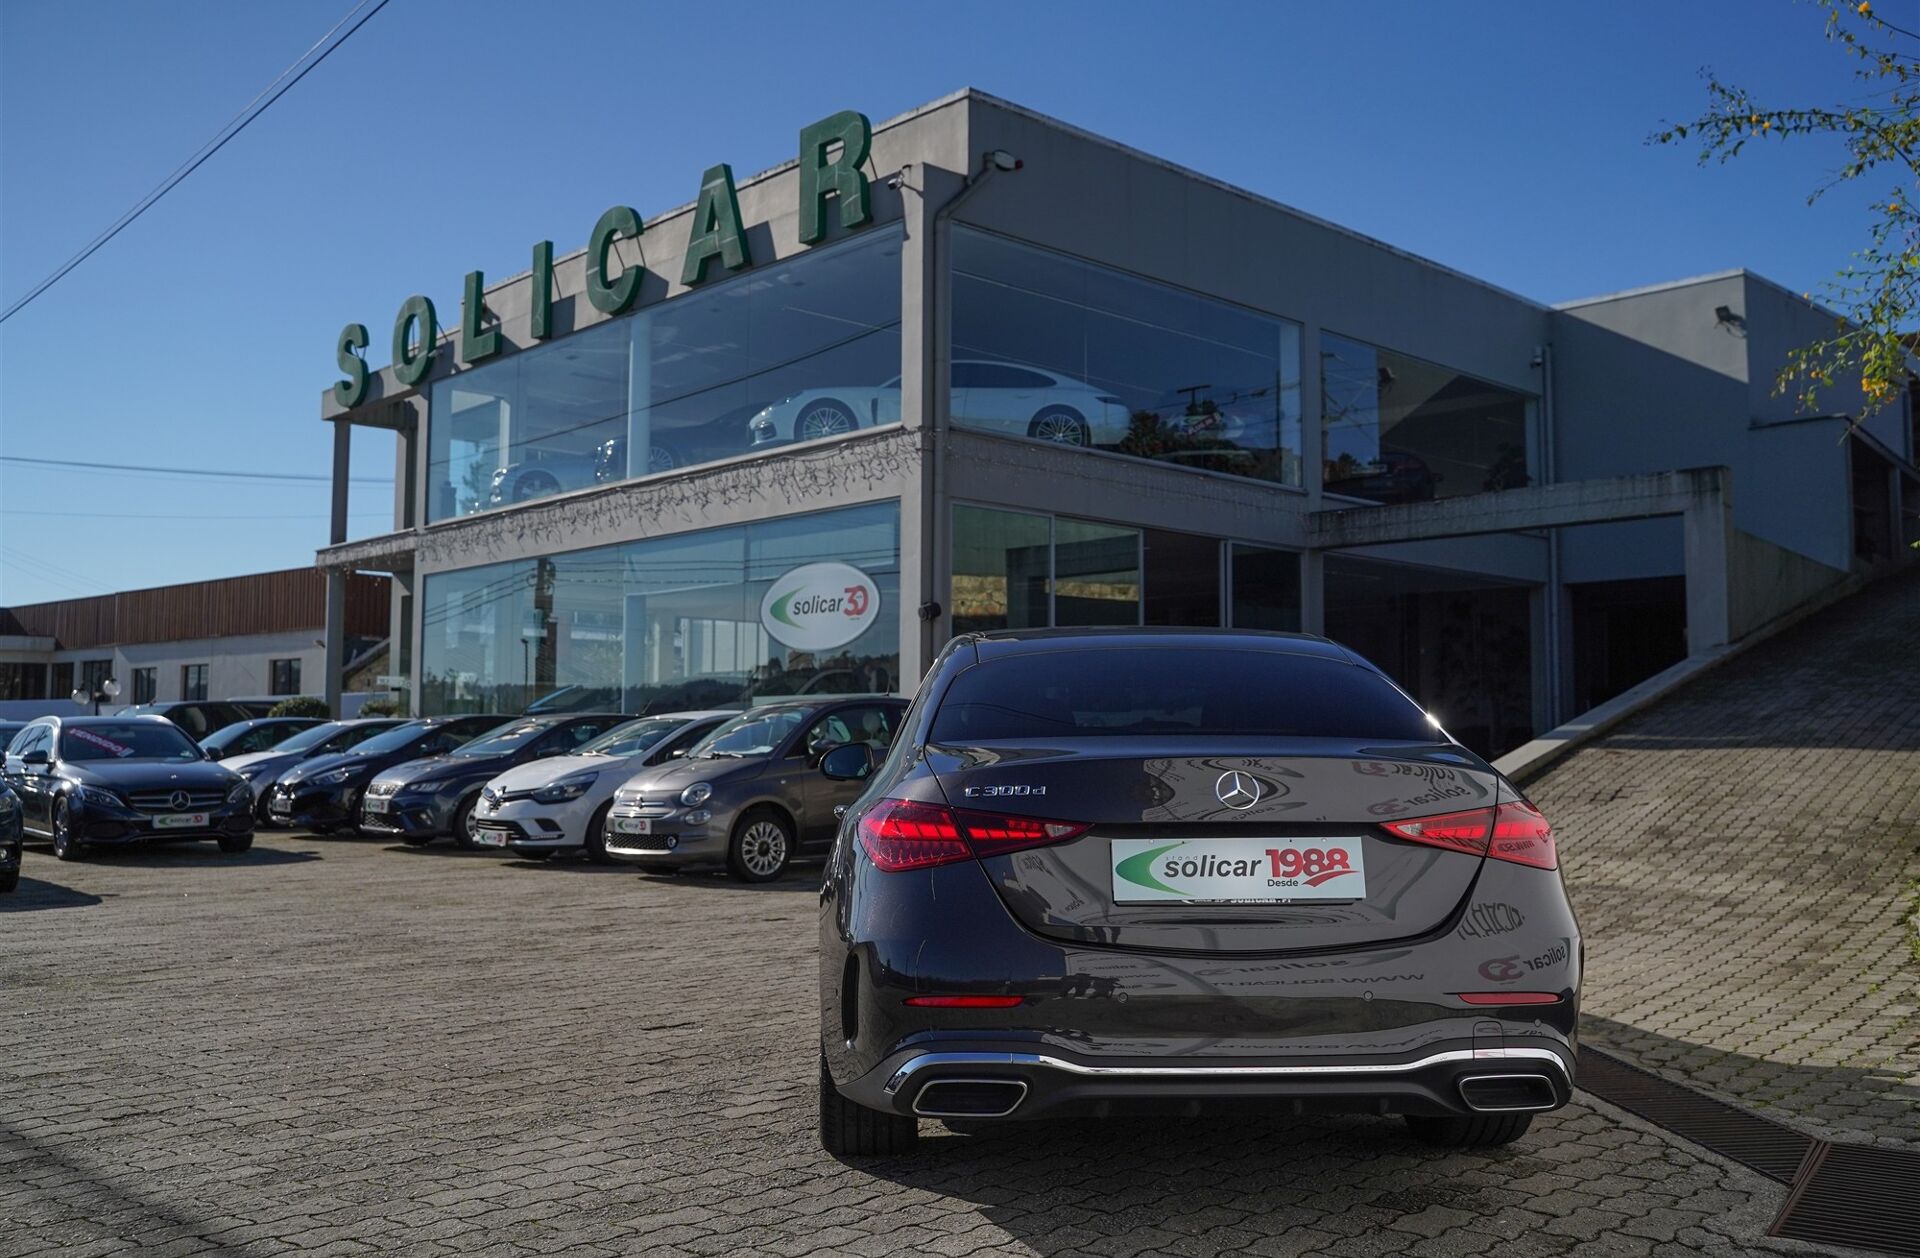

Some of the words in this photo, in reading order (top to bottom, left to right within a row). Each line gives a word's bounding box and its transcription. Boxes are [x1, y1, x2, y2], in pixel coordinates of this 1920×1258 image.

[335, 110, 872, 409] SOLICAR
[793, 595, 844, 615] solicar
[843, 585, 869, 616] 30
[1163, 854, 1262, 878] solicar
[1265, 848, 1350, 878] 1988
[1267, 879, 1299, 888] Desde
